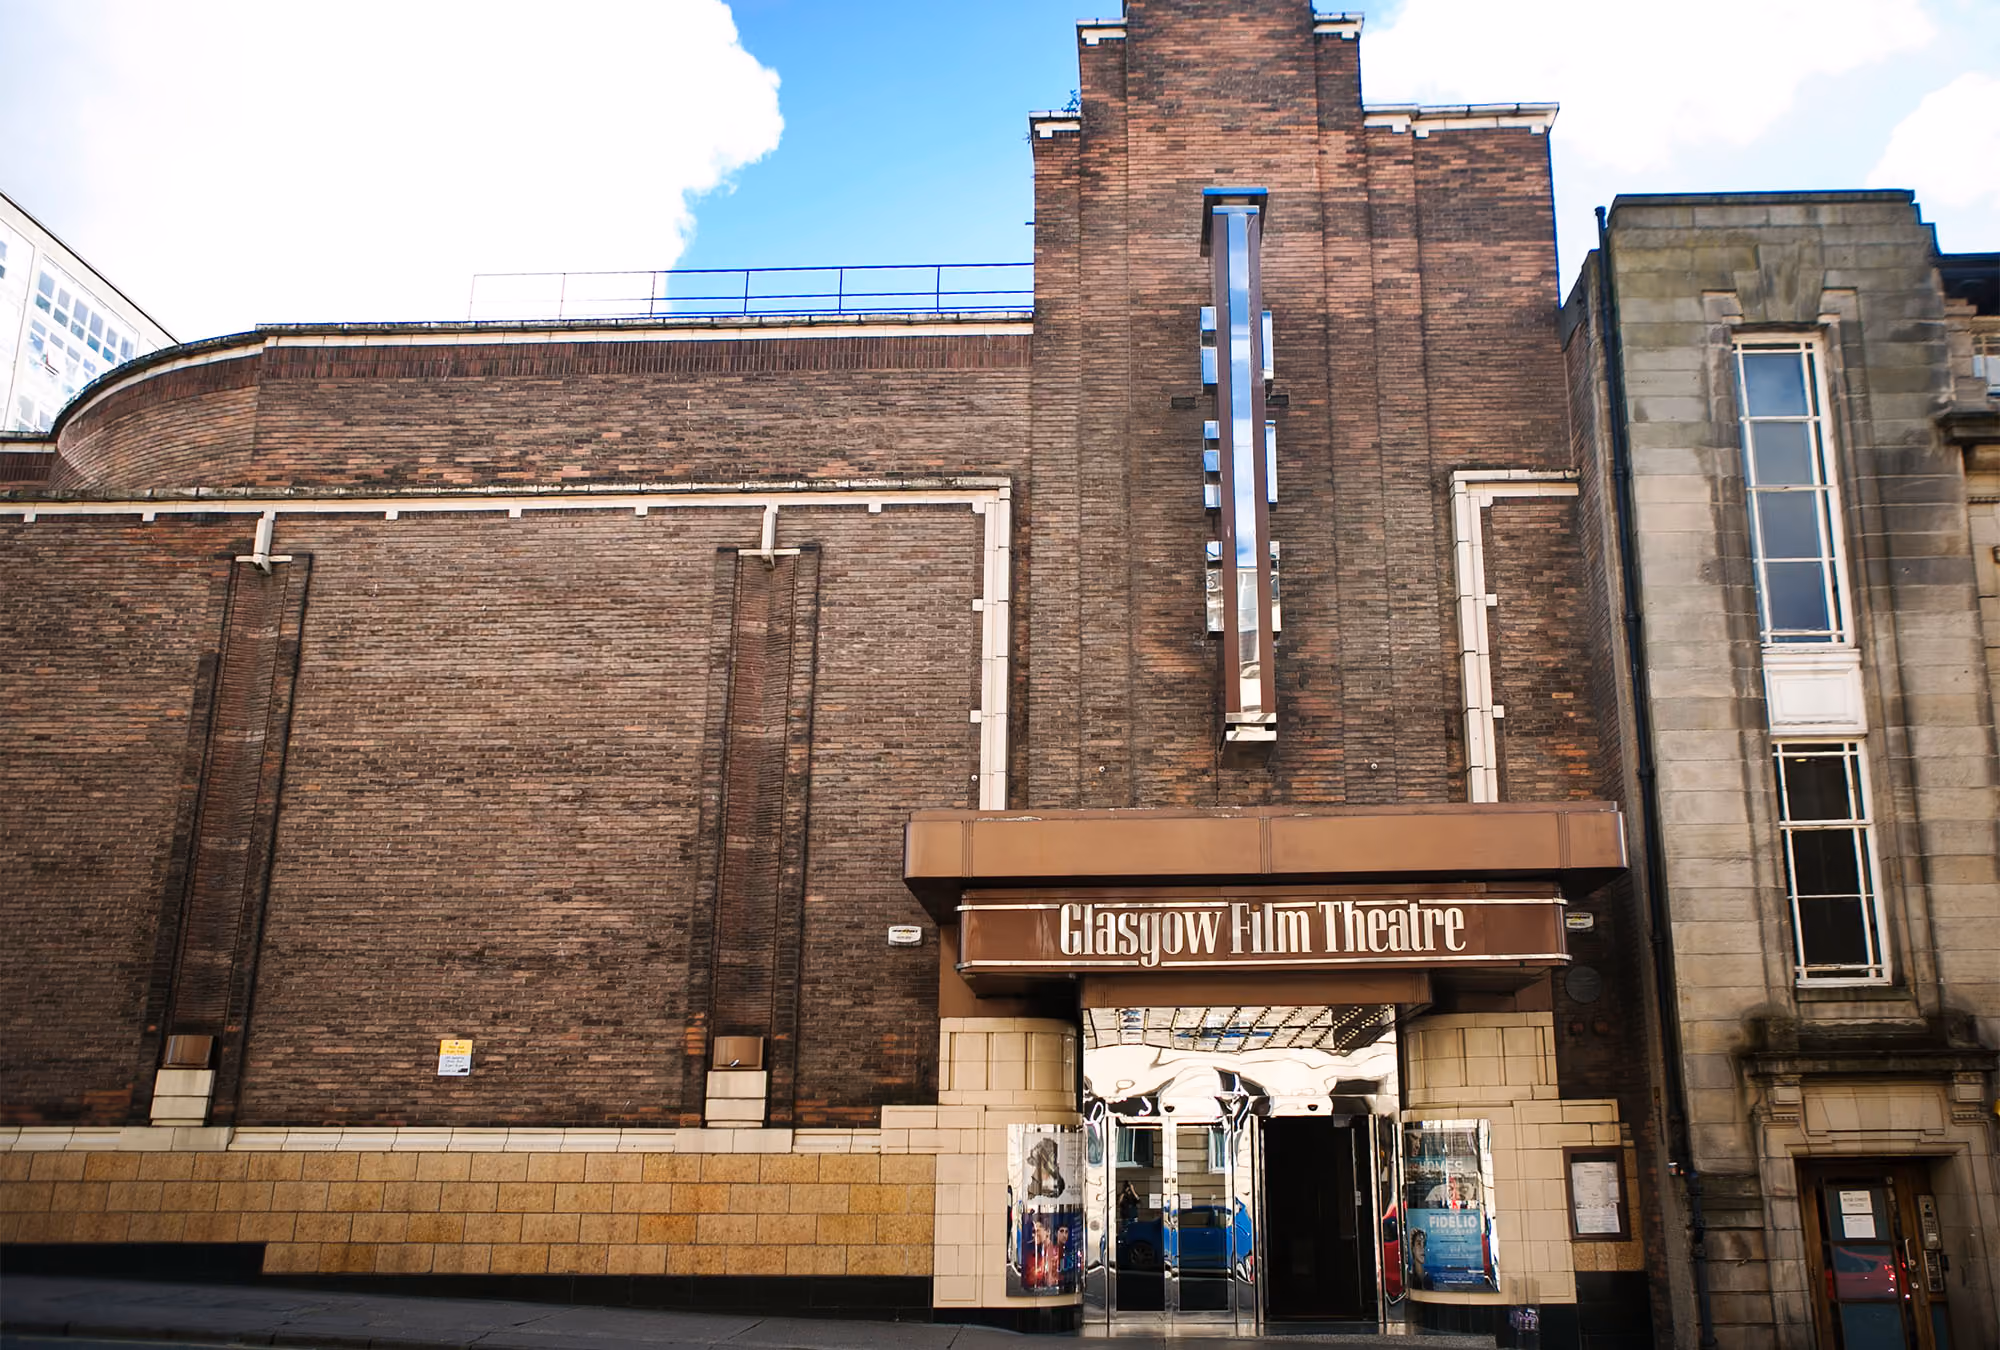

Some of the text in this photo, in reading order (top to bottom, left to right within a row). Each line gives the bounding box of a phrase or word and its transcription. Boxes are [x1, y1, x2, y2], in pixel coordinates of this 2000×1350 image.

[1059, 900, 1467, 967] Glasgow Film Theatre
[1429, 1215, 1478, 1228] FIDELIO
